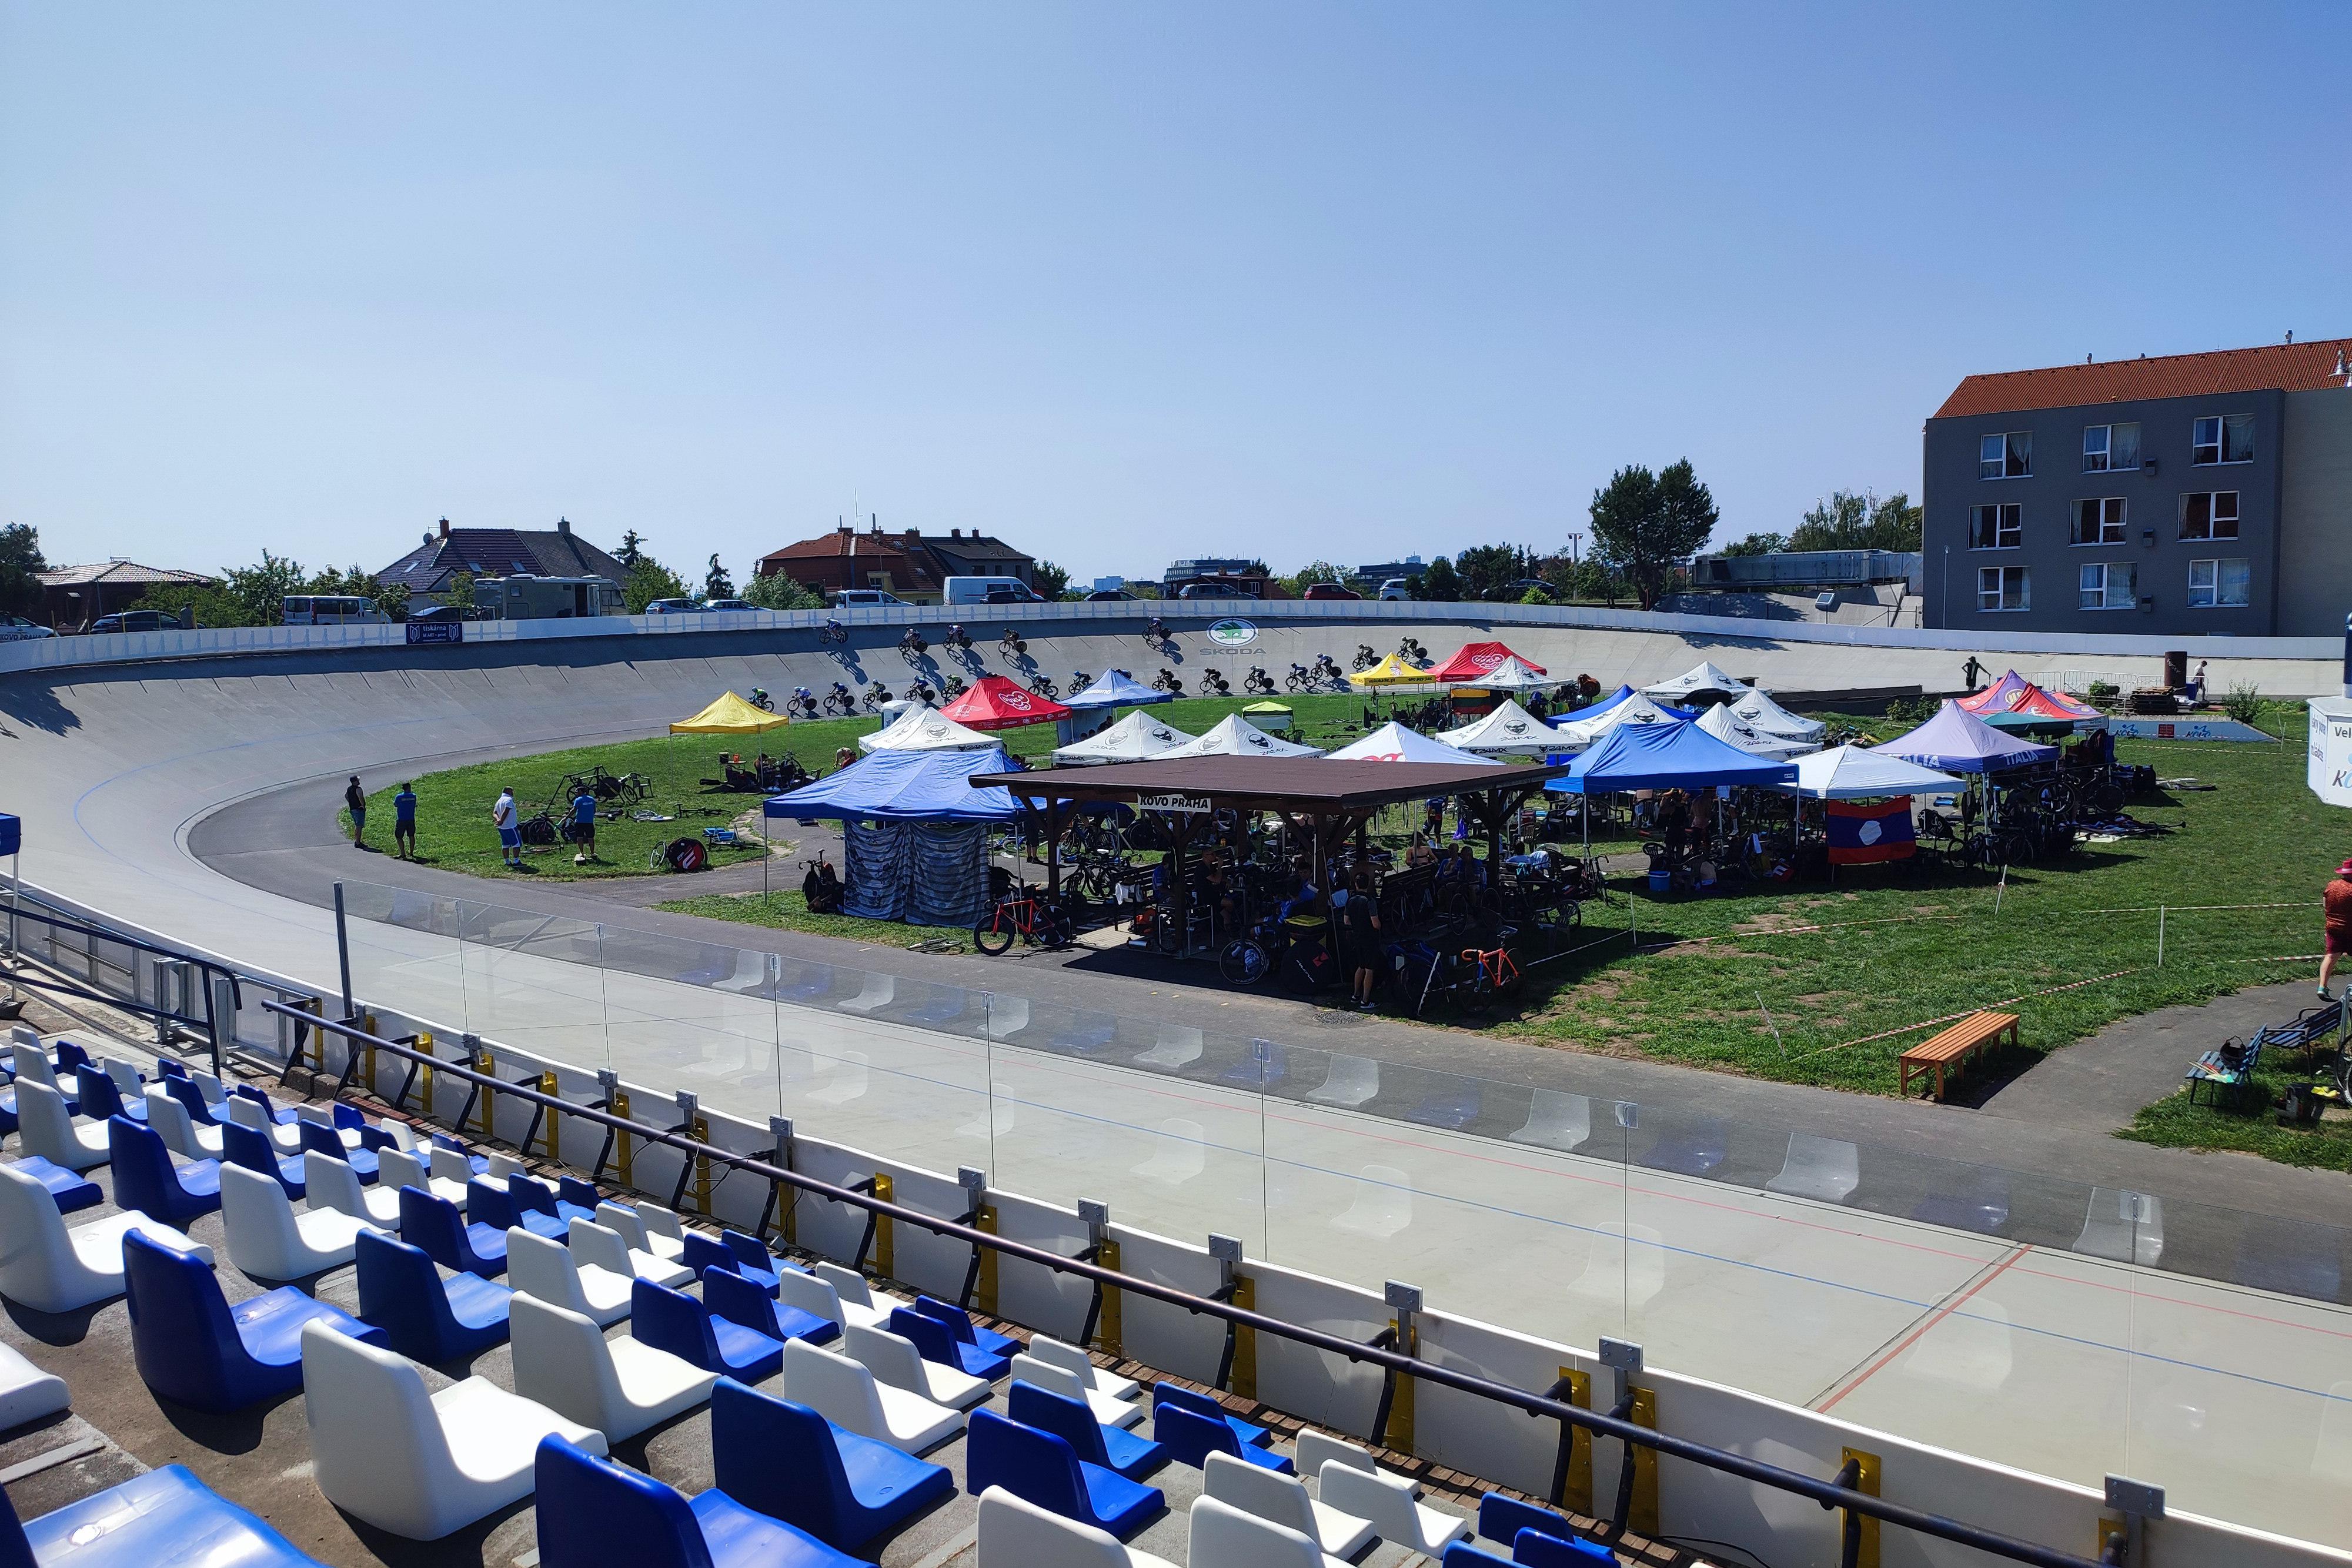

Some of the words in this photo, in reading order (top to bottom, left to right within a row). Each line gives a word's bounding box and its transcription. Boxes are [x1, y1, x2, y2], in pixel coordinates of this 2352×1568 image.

[2005, 750, 2039, 765] ITALIA
[1140, 797, 1169, 807] KOVO
[1171, 798, 1208, 809] PRAHA
